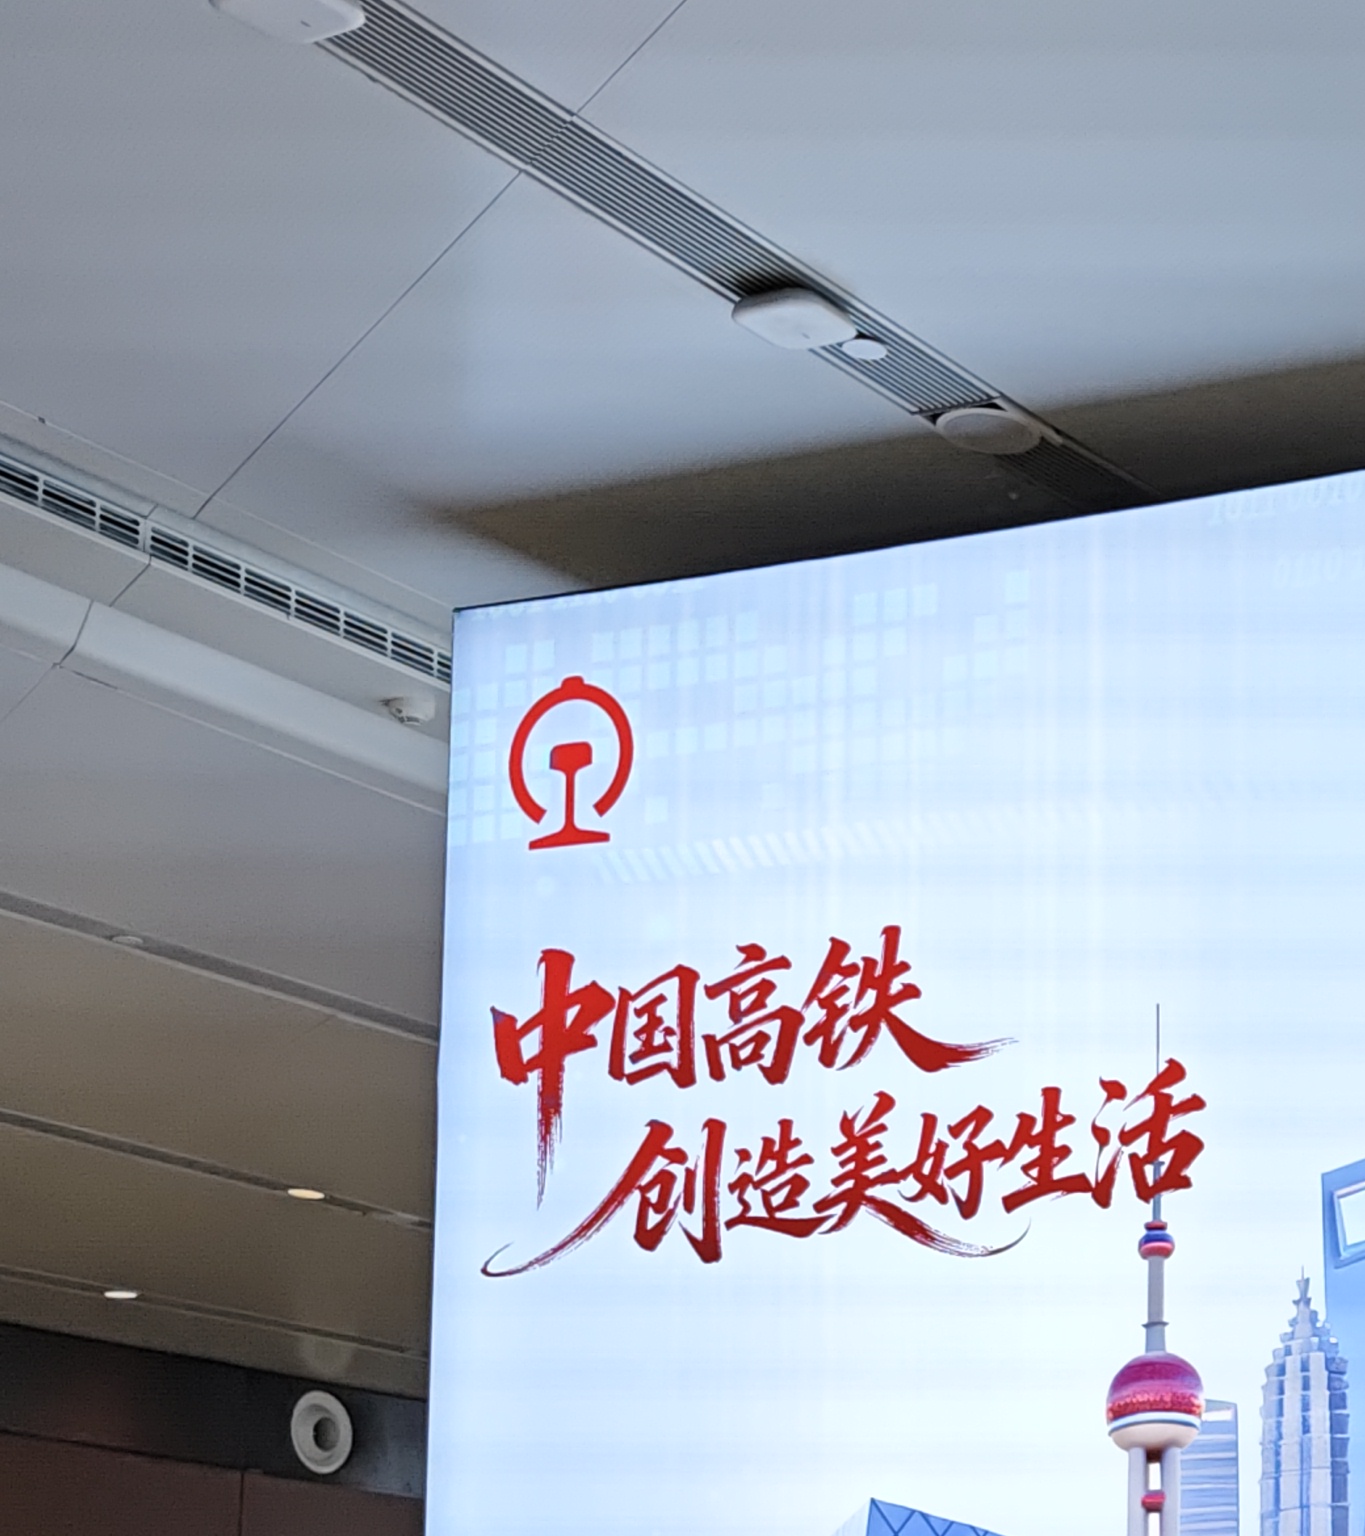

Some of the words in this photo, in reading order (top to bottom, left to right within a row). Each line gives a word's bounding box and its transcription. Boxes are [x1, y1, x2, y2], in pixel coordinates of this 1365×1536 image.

[481, 1059, 1206, 1277] 创造美好生活
[490, 925, 1019, 1210] 中国高铁
